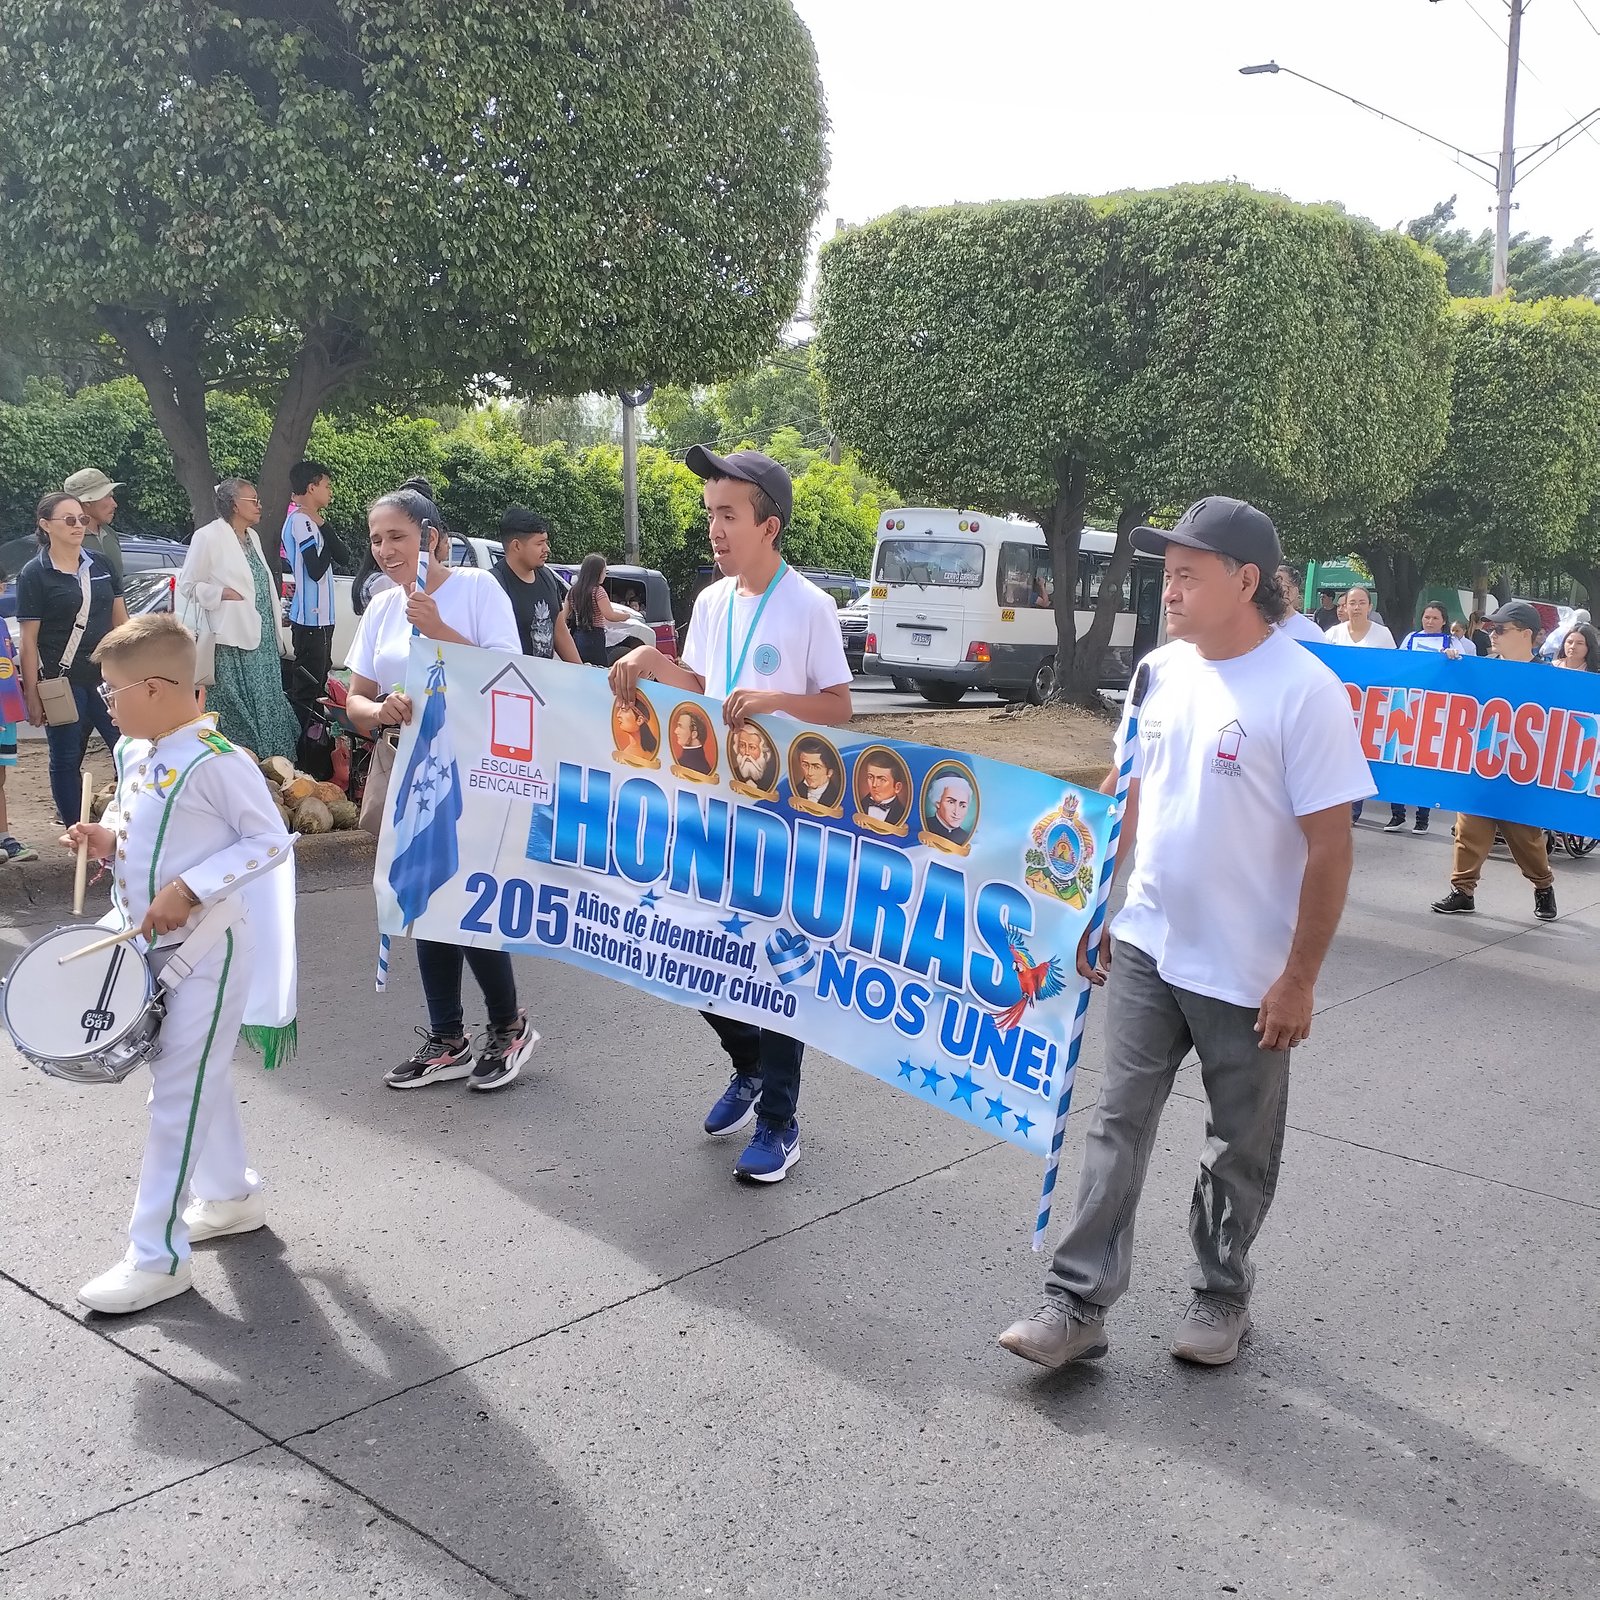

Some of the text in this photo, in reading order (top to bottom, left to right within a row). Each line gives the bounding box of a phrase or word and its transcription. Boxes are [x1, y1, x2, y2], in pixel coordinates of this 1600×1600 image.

[872, 588, 888, 597] 0602
[481, 758, 543, 781] ESCUELA
[1211, 758, 1241, 771] ESCUELA
[1345, 682, 1600, 797] ENEROSID
[469, 773, 549, 800] BENCALETH
[459, 872, 569, 946] 205
[554, 760, 1034, 1010] HONDURAS
[572, 922, 798, 1020] historia y fervor cívico
[574, 890, 759, 974] Años de identidad,
[816, 948, 1058, 1099] NOS UNE!
